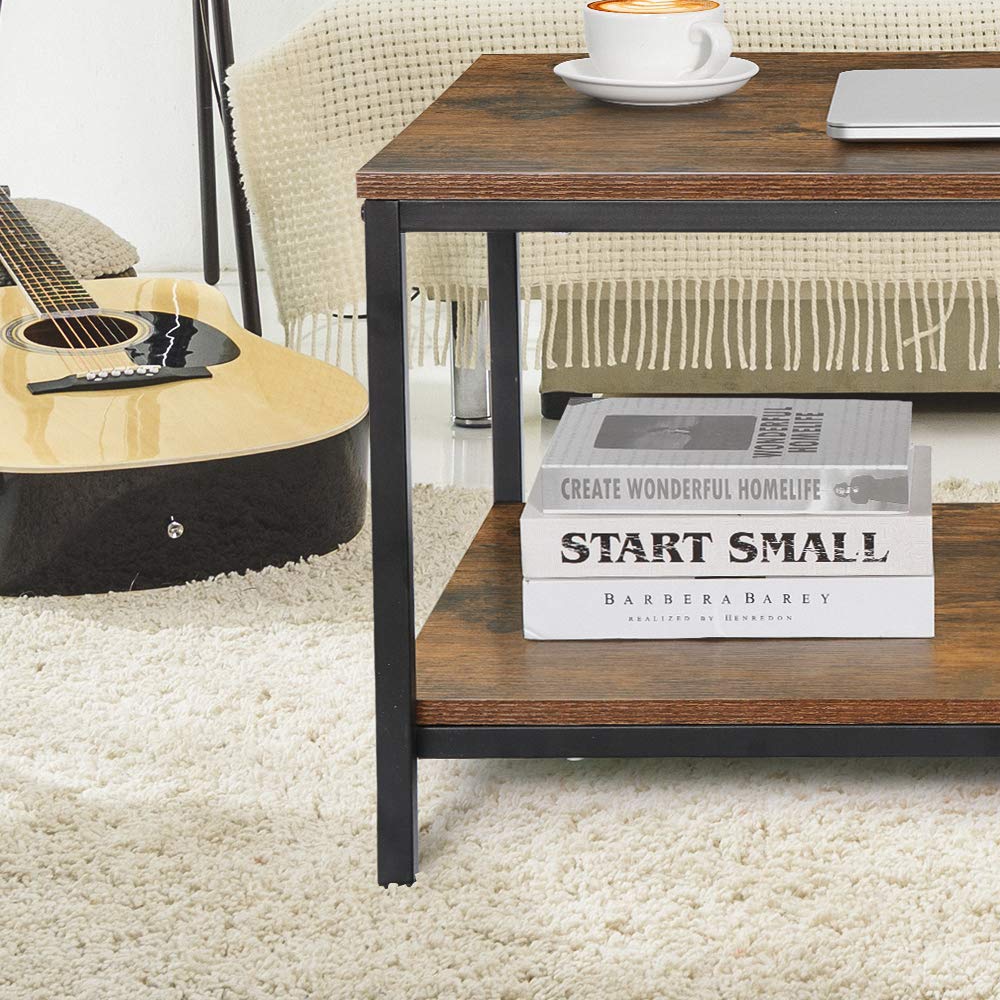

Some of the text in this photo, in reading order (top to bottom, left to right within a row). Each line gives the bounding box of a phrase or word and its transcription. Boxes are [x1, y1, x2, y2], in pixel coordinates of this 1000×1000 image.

[752, 407, 793, 458] WONDERFUL
[788, 412, 825, 453] HOMELIFE
[561, 478, 821, 500] CREATE WONDERFUL HOMELIFE
[561, 532, 889, 563] START SMALL
[604, 592, 830, 605] BARBERA BAREY
